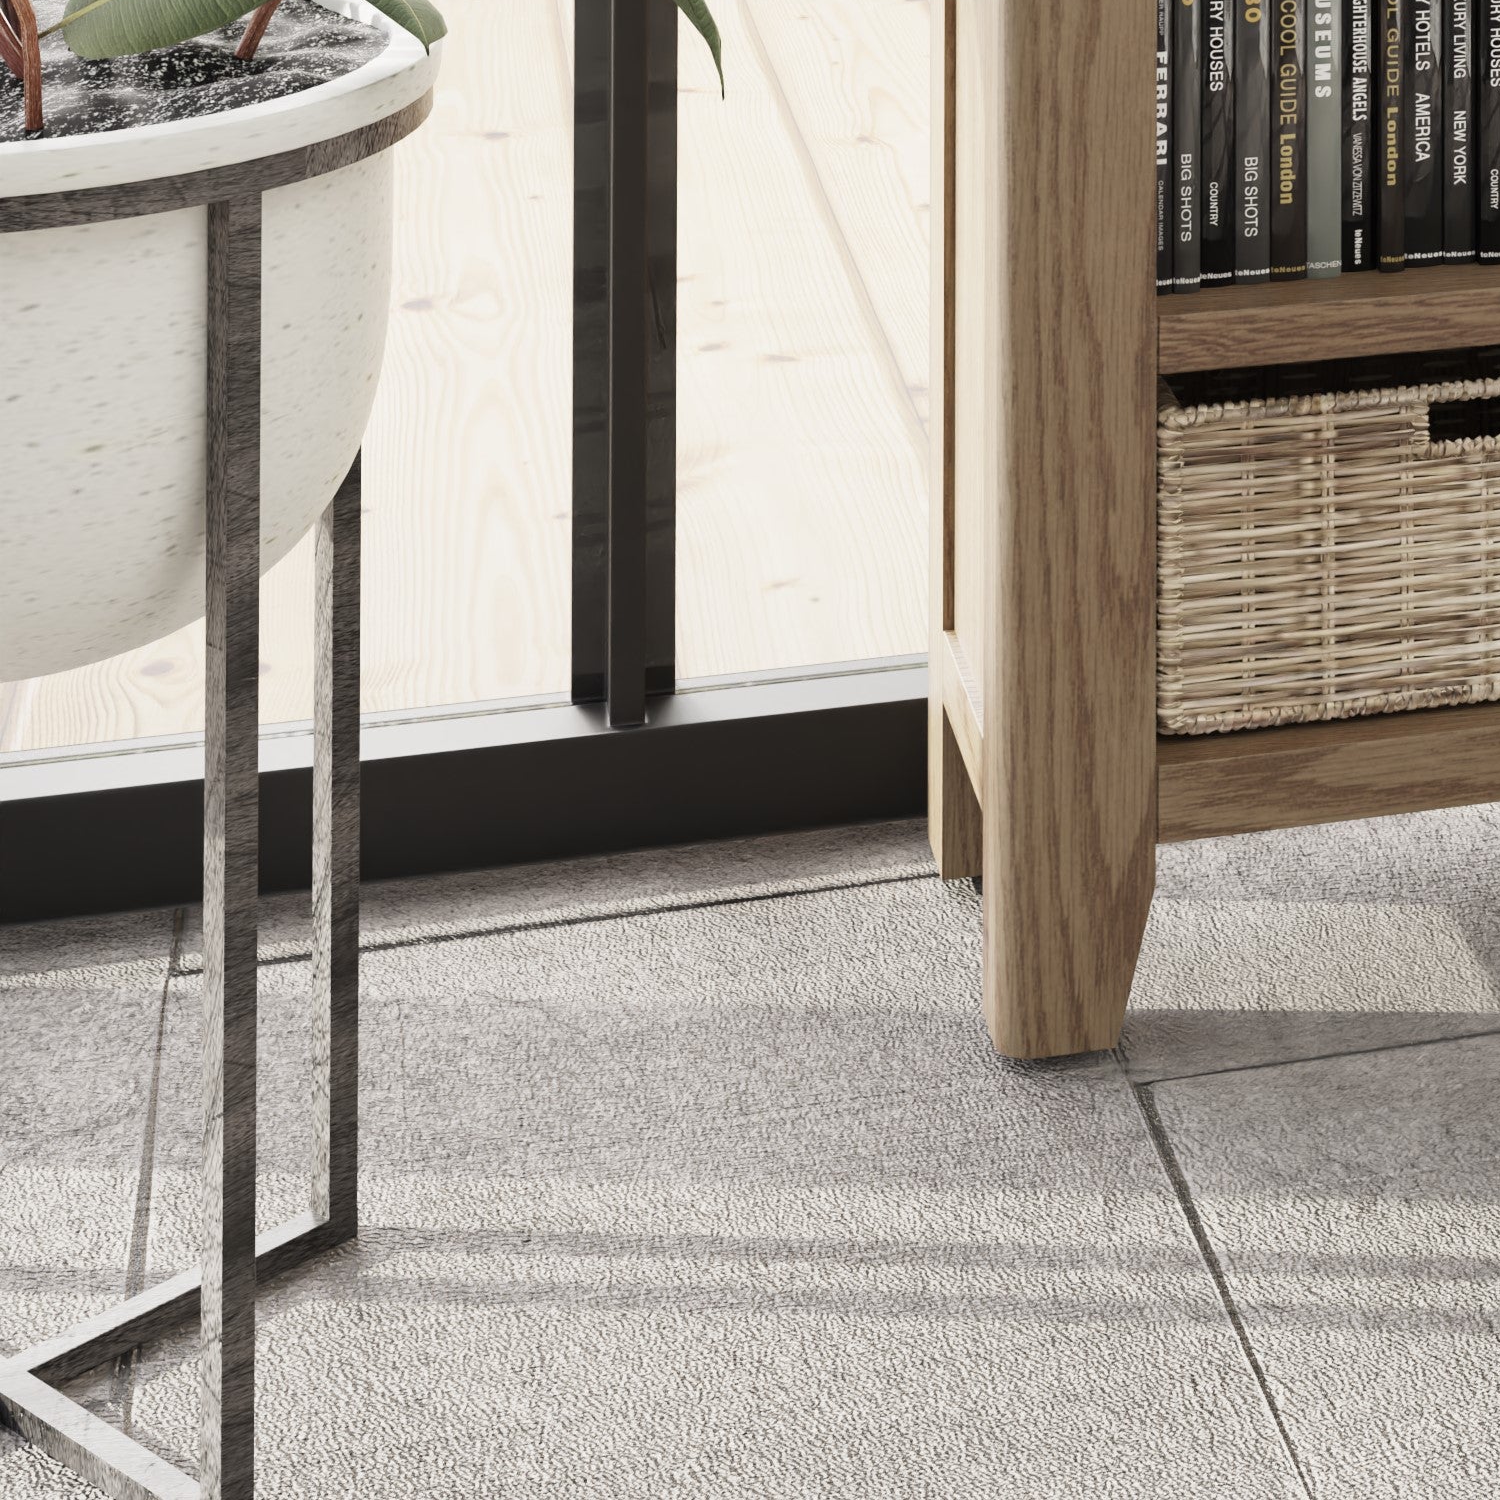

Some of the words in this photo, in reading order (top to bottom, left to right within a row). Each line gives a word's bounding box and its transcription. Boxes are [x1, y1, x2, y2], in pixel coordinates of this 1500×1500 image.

[1280, 0, 1297, 56] COOL
[1415, 12, 1431, 71] HOTELS
[1209, 26, 1224, 92] HOUSES
[1387, 28, 1399, 97] GUIDE
[1453, 35, 1466, 79] LIVING
[1156, 50, 1168, 165] FERRARI
[1280, 63, 1297, 125] GUIDE
[1352, 77, 1367, 122] ANGELS
[1352, 132, 1362, 164] VANESSA
[1387, 106, 1399, 186] London
[1415, 92, 1431, 163] AMERICA
[1453, 110, 1466, 142] NEW
[1180, 153, 1192, 181] BIG
[1244, 156, 1259, 181] BIG
[1279, 133, 1296, 205] London
[1352, 164, 1362, 181] VON
[1453, 145, 1466, 185] YORK
[1490, 168, 1499, 210] COUNTRY
[1180, 186, 1192, 242] SHOTS
[1209, 181, 1219, 227] COUNTRY
[1244, 185, 1259, 238] SHOTS
